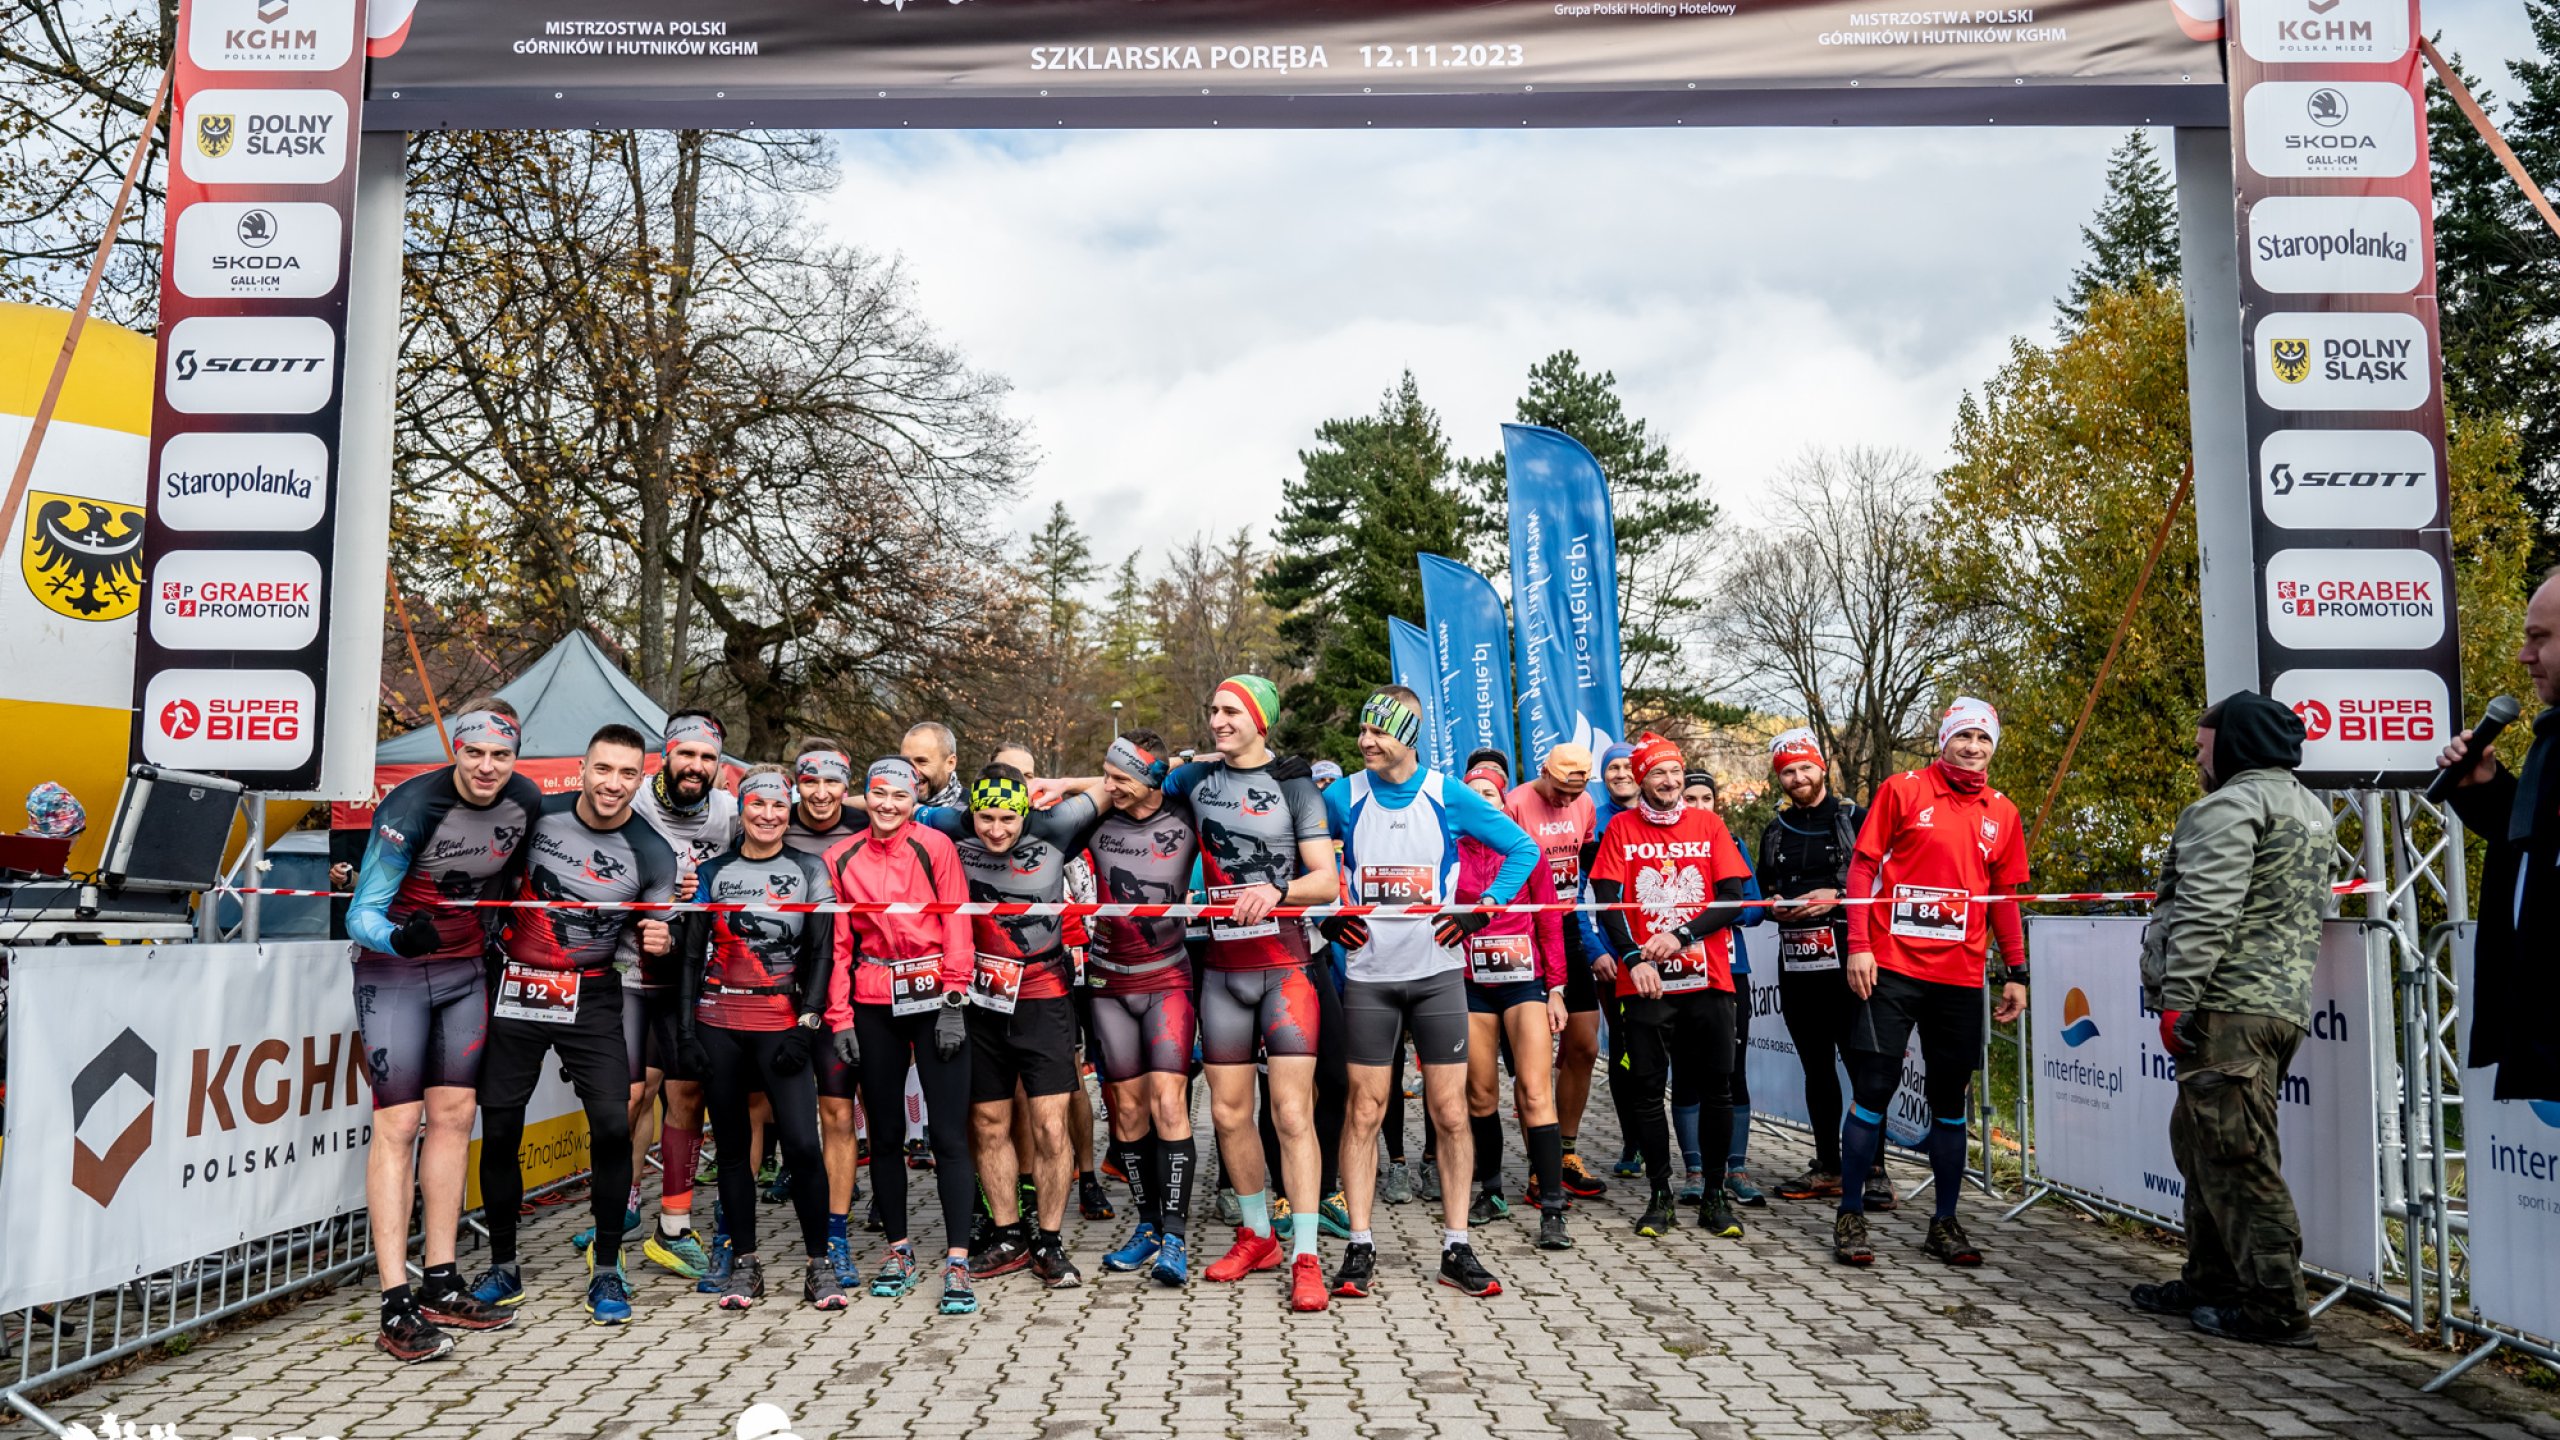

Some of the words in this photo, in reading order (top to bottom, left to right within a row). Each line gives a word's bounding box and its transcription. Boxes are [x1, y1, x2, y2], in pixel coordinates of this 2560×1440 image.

[1555, 4, 1590, 17] Grupa
[1593, 3, 1626, 15] Polski
[1630, 3, 1676, 17] Holding
[1679, 2, 1736, 15] Hotelowy
[1850, 9, 1970, 26] MISTRZOSTWA
[1975, 9, 2033, 24] POLSKI
[546, 22, 665, 35] MISTRZOSTWA
[670, 22, 726, 35] POLSKI
[1818, 29, 1909, 45] GÓRNIKÓW
[1913, 31, 1918, 44] I
[1922, 27, 2012, 44] HUTNIKÓW
[2016, 28, 2067, 42] KGHM
[2279, 21, 2372, 41] KGHM
[225, 30, 317, 49] KGHM
[513, 38, 605, 54] GÓRNIKÓW
[607, 42, 612, 54] I
[616, 39, 705, 55] HUTNIKÓW
[709, 41, 758, 55] KGHM
[1030, 47, 1202, 69] SZKLARSKA
[1210, 45, 1328, 74] PORĘBA
[1359, 44, 1523, 68] 12.11.2023
[247, 115, 333, 134] DOLNY
[246, 132, 325, 157] ŚLĄSK
[2307, 155, 2358, 165] GALL-ICM
[2258, 228, 2407, 261] Staropolanka
[231, 276, 280, 285] GALL-ICM
[2324, 339, 2411, 358] DOLNY
[201, 358, 325, 372] SCOTT
[2325, 357, 2408, 383] ŚLĄSK
[167, 465, 312, 499] Staropolanka
[2299, 472, 2426, 486] SCOTT
[184, 586, 193, 597] P
[200, 582, 309, 602] GRABEK
[2300, 584, 2310, 596] P
[2317, 581, 2431, 601] GRABEK
[165, 602, 176, 614] G
[199, 603, 309, 618] PROMOTION
[2282, 602, 2294, 614] G
[2318, 603, 2433, 616] PROMOTION
[209, 700, 298, 713] SUPER
[2339, 700, 2432, 713] SUPER
[207, 716, 298, 740] BIEG
[2339, 717, 2434, 741] BIEG
[544, 777, 561, 788] tel.
[564, 776, 583, 788] 602
[1539, 821, 1575, 836] HOKA
[1623, 841, 1712, 861] POLSKA
[1552, 872, 1566, 885] 04
[1381, 882, 1411, 897] 145
[1919, 904, 1939, 919] 84
[1795, 943, 1818, 955] 209
[1492, 951, 1508, 966] 91
[1664, 959, 1682, 973] 20
[526, 983, 548, 999] 92
[915, 975, 935, 992] 89
[2141, 1043, 2147, 1076] i
[2153, 1051, 2176, 1081] na
[2044, 1053, 2122, 1098] interferie.pl
[1898, 1091, 1931, 1128] 2000
[183, 1142, 296, 1188] POLSKA
[312, 1125, 372, 1156] MIED
[2491, 1134, 2559, 1182] inter
[2143, 1171, 2185, 1199] www.
